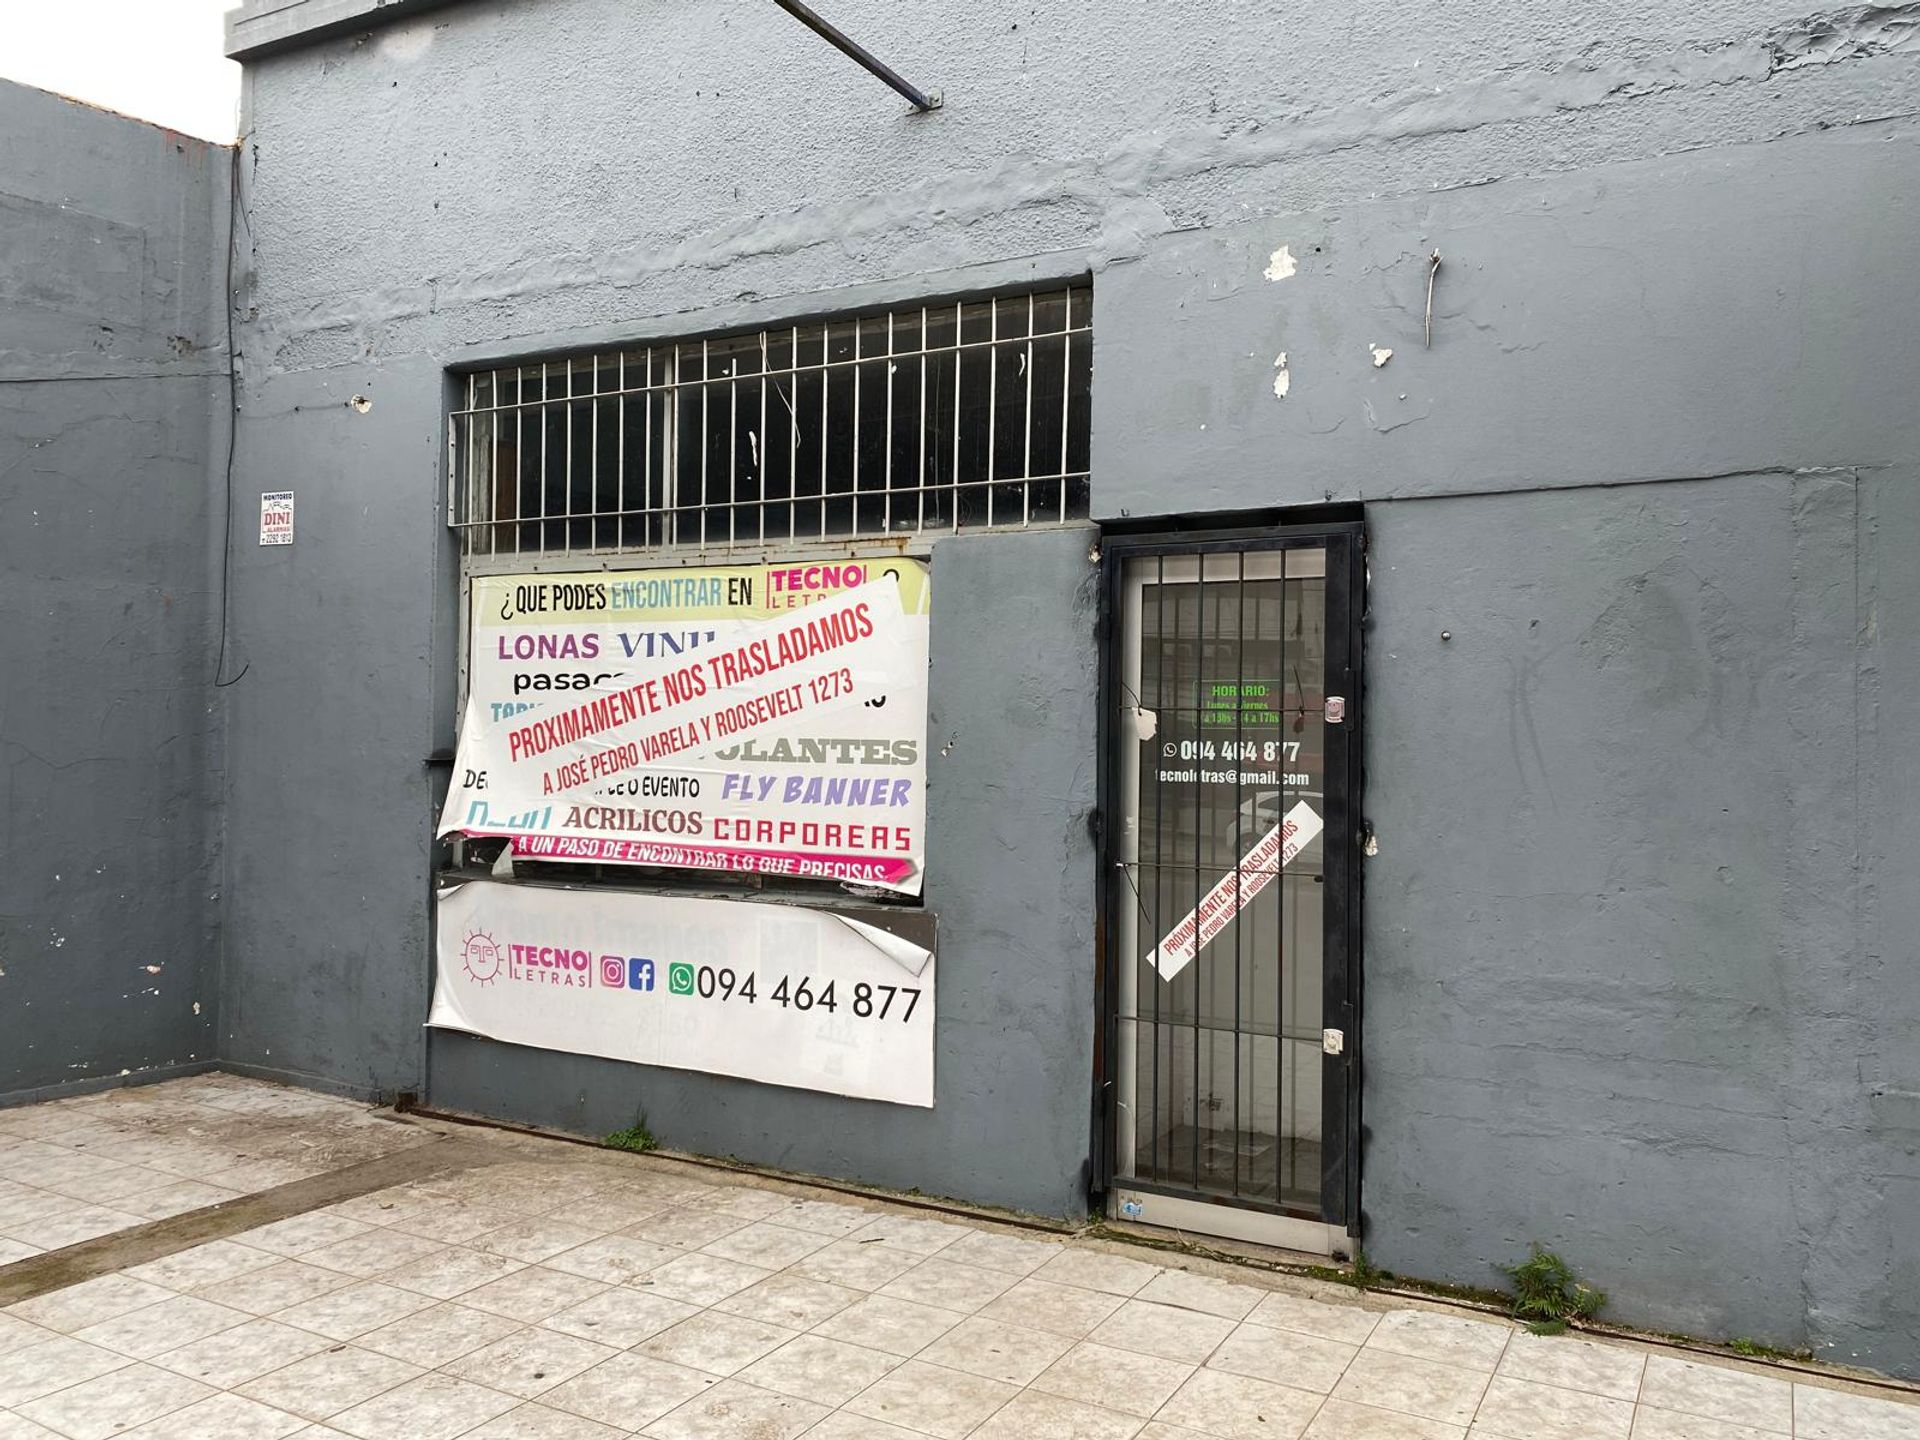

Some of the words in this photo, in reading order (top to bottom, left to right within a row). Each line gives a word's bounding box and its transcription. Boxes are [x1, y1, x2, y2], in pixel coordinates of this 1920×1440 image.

[264, 512, 290, 525] DINI
[771, 565, 863, 592] TECNO
[553, 583, 606, 611] PODES
[611, 577, 721, 609] ENCONTRAR
[728, 577, 752, 606] EN
[498, 633, 599, 660] LONAS
[509, 680, 661, 762] PROXIMAMENTE
[662, 664, 706, 707] NOS
[708, 602, 873, 690] TRASLADAMOS
[543, 771, 554, 795] A
[556, 755, 590, 792] JOSÉ
[591, 742, 639, 779] PEDRO
[640, 722, 700, 762] VARELA
[700, 715, 712, 741] Y
[715, 684, 803, 737] ROOSEVELT
[808, 667, 854, 704] 1273
[702, 738, 918, 765] LANTES
[1180, 740, 1216, 760] 094
[642, 776, 700, 797] EVENTO
[721, 773, 777, 801] FLY
[783, 776, 912, 807] BANNER
[562, 806, 703, 835] ACRILICOS
[714, 818, 911, 851] CORPOREAS
[518, 836, 527, 852] A
[531, 837, 553, 854] UN
[556, 838, 600, 856] PASO
[602, 842, 626, 859] DE
[627, 843, 728, 868] ENCONTRAR
[732, 854, 755, 871] LO
[758, 856, 795, 874] QUE
[1203, 916, 1225, 940] PEDRO
[512, 944, 588, 971] TECNO
[514, 968, 585, 988] LETRAS
[698, 965, 757, 1004] 094
[771, 975, 837, 1013] 464
[853, 982, 921, 1023] 877
